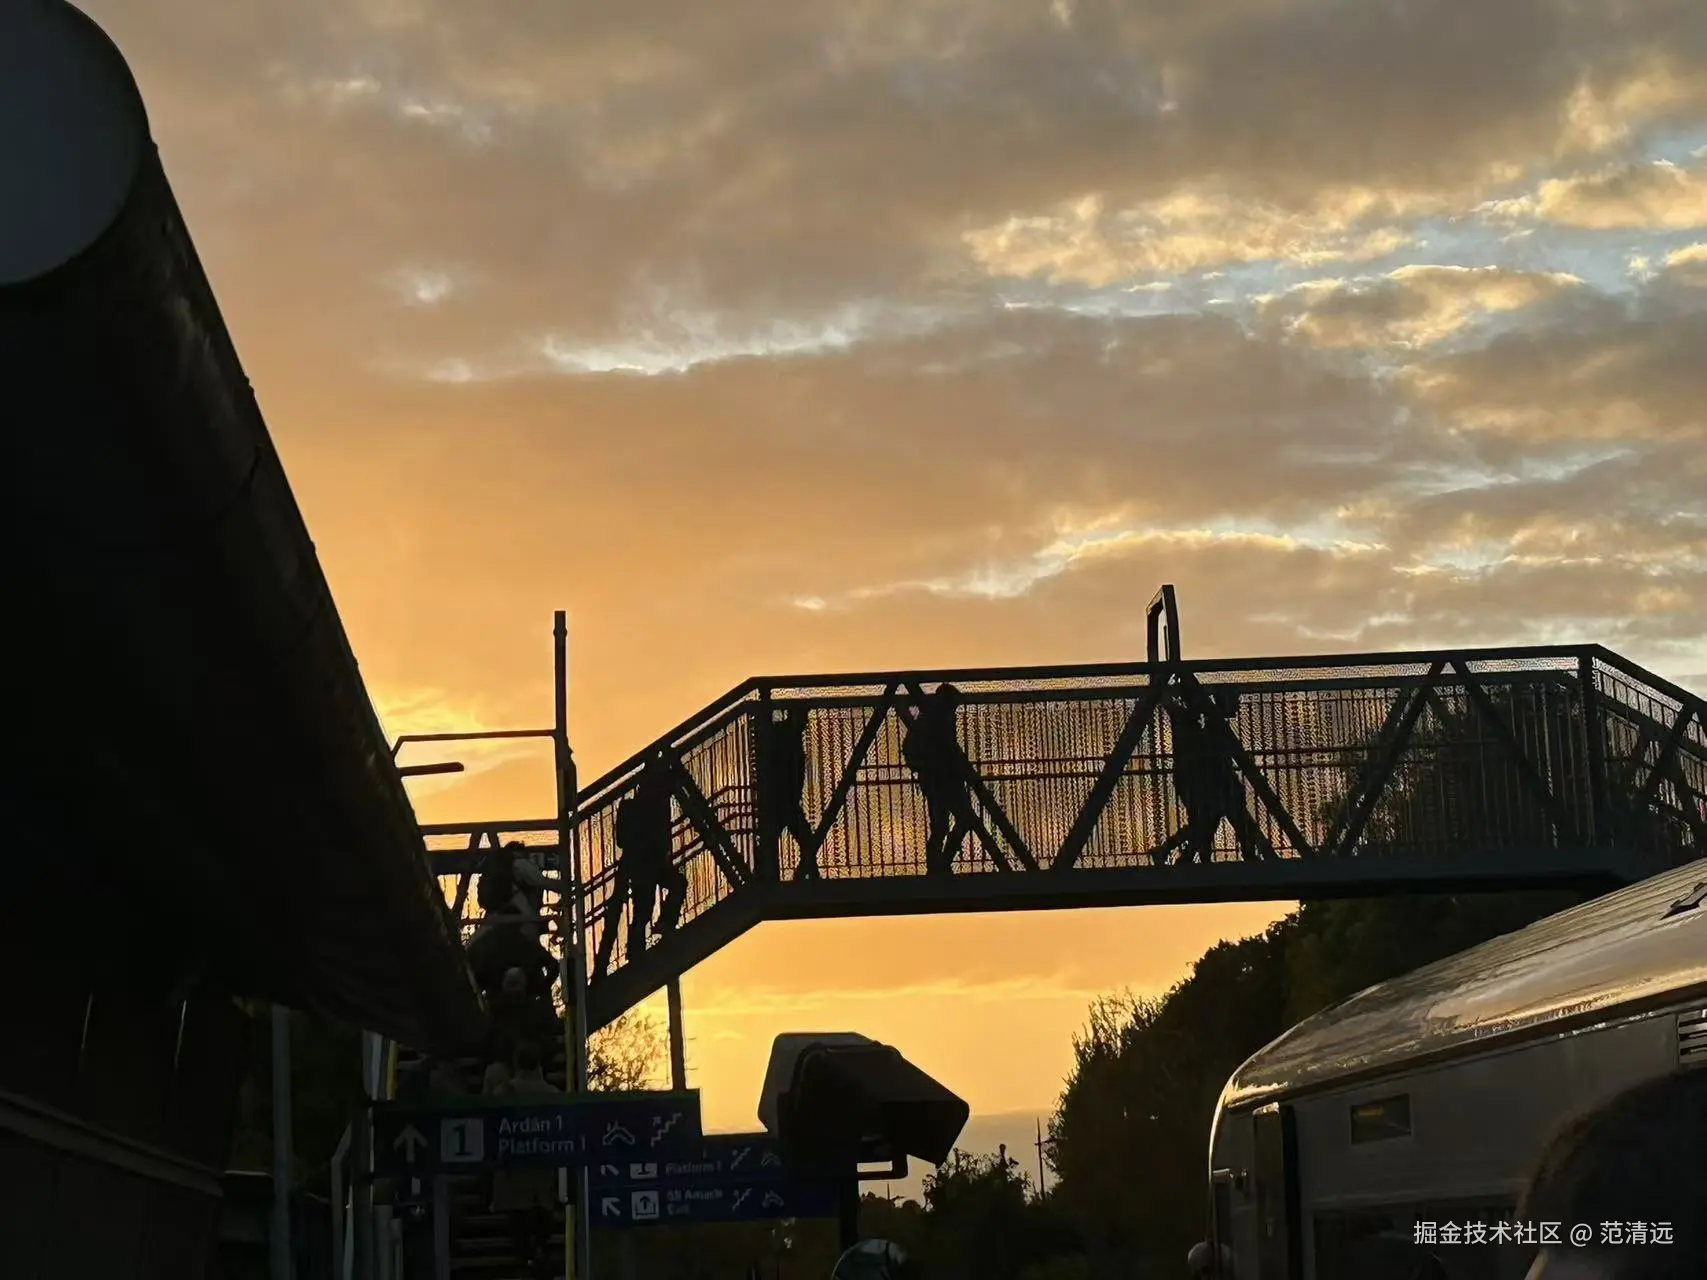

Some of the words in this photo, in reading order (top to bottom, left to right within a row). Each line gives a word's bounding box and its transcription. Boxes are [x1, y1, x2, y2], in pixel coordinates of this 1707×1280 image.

[555, 1114, 563, 1130] 1
[453, 1126, 473, 1156] 1
[498, 1137, 574, 1154] Platform
